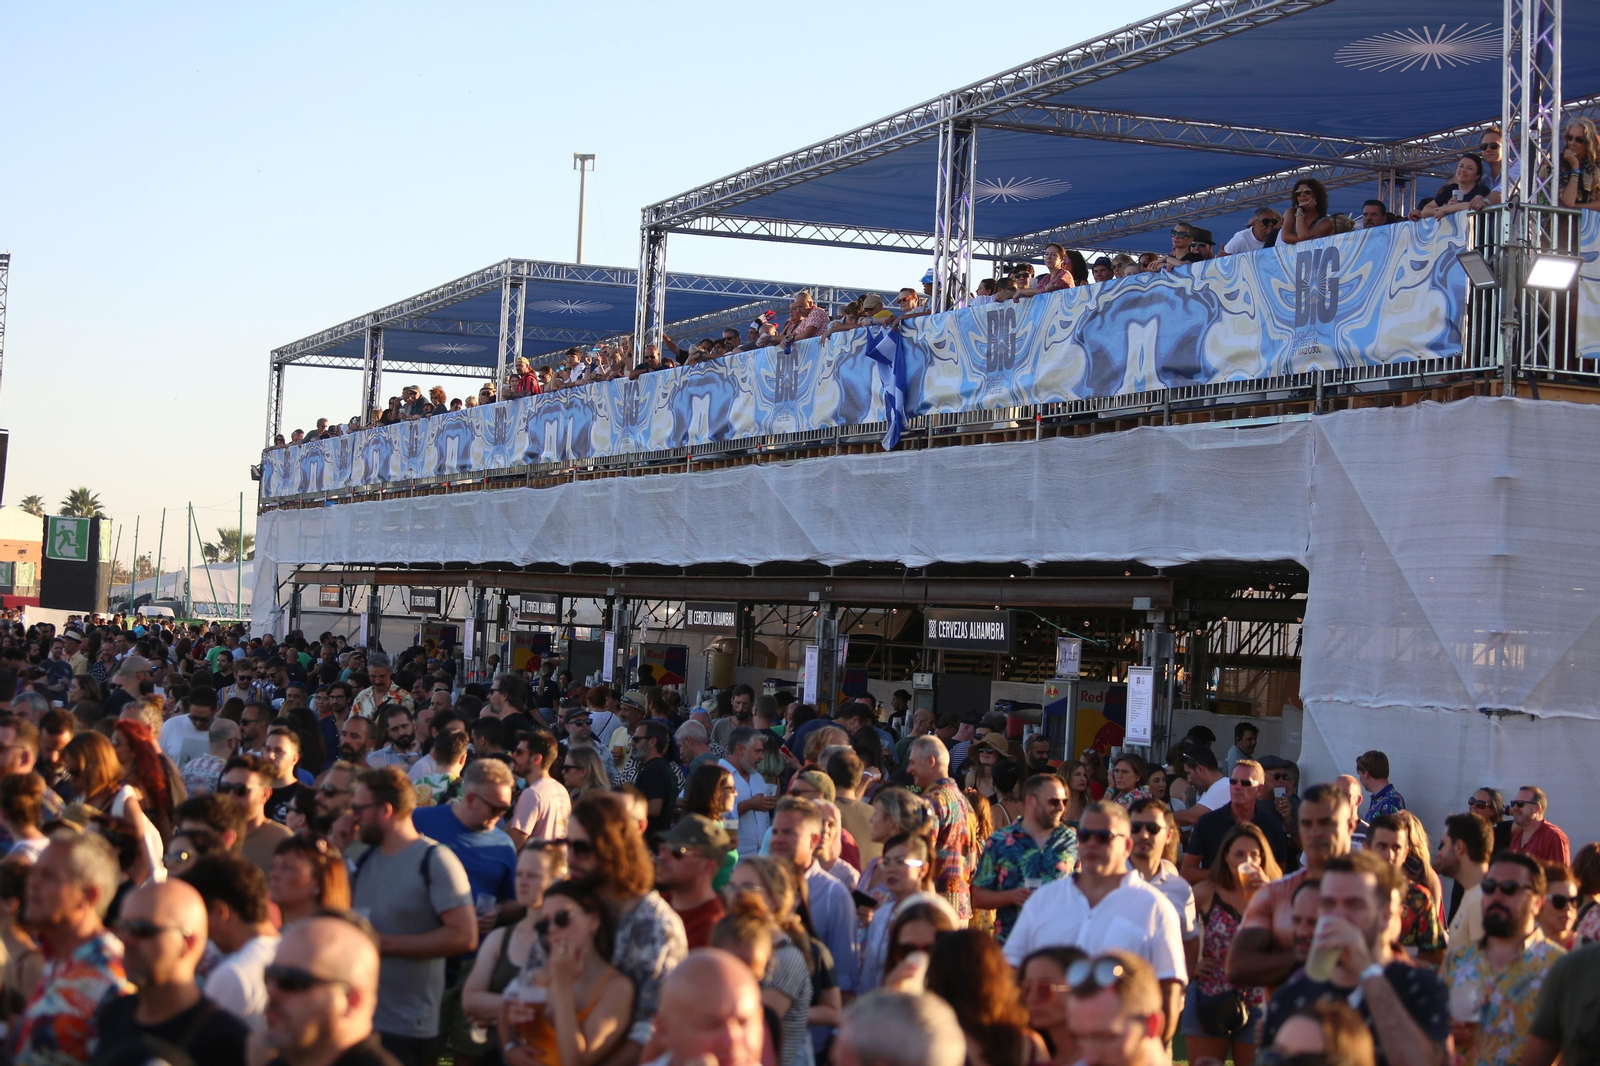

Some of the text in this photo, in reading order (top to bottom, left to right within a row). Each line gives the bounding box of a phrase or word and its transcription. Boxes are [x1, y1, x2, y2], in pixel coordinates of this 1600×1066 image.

[1295, 246, 1340, 328] BIG
[987, 307, 1016, 373] BIG
[427, 628, 440, 636] Red
[939, 620, 1005, 640] CERVEZAS ALHAMBRA
[517, 636, 532, 644] Red
[647, 650, 664, 659] Red
[1081, 690, 1103, 703] Red
